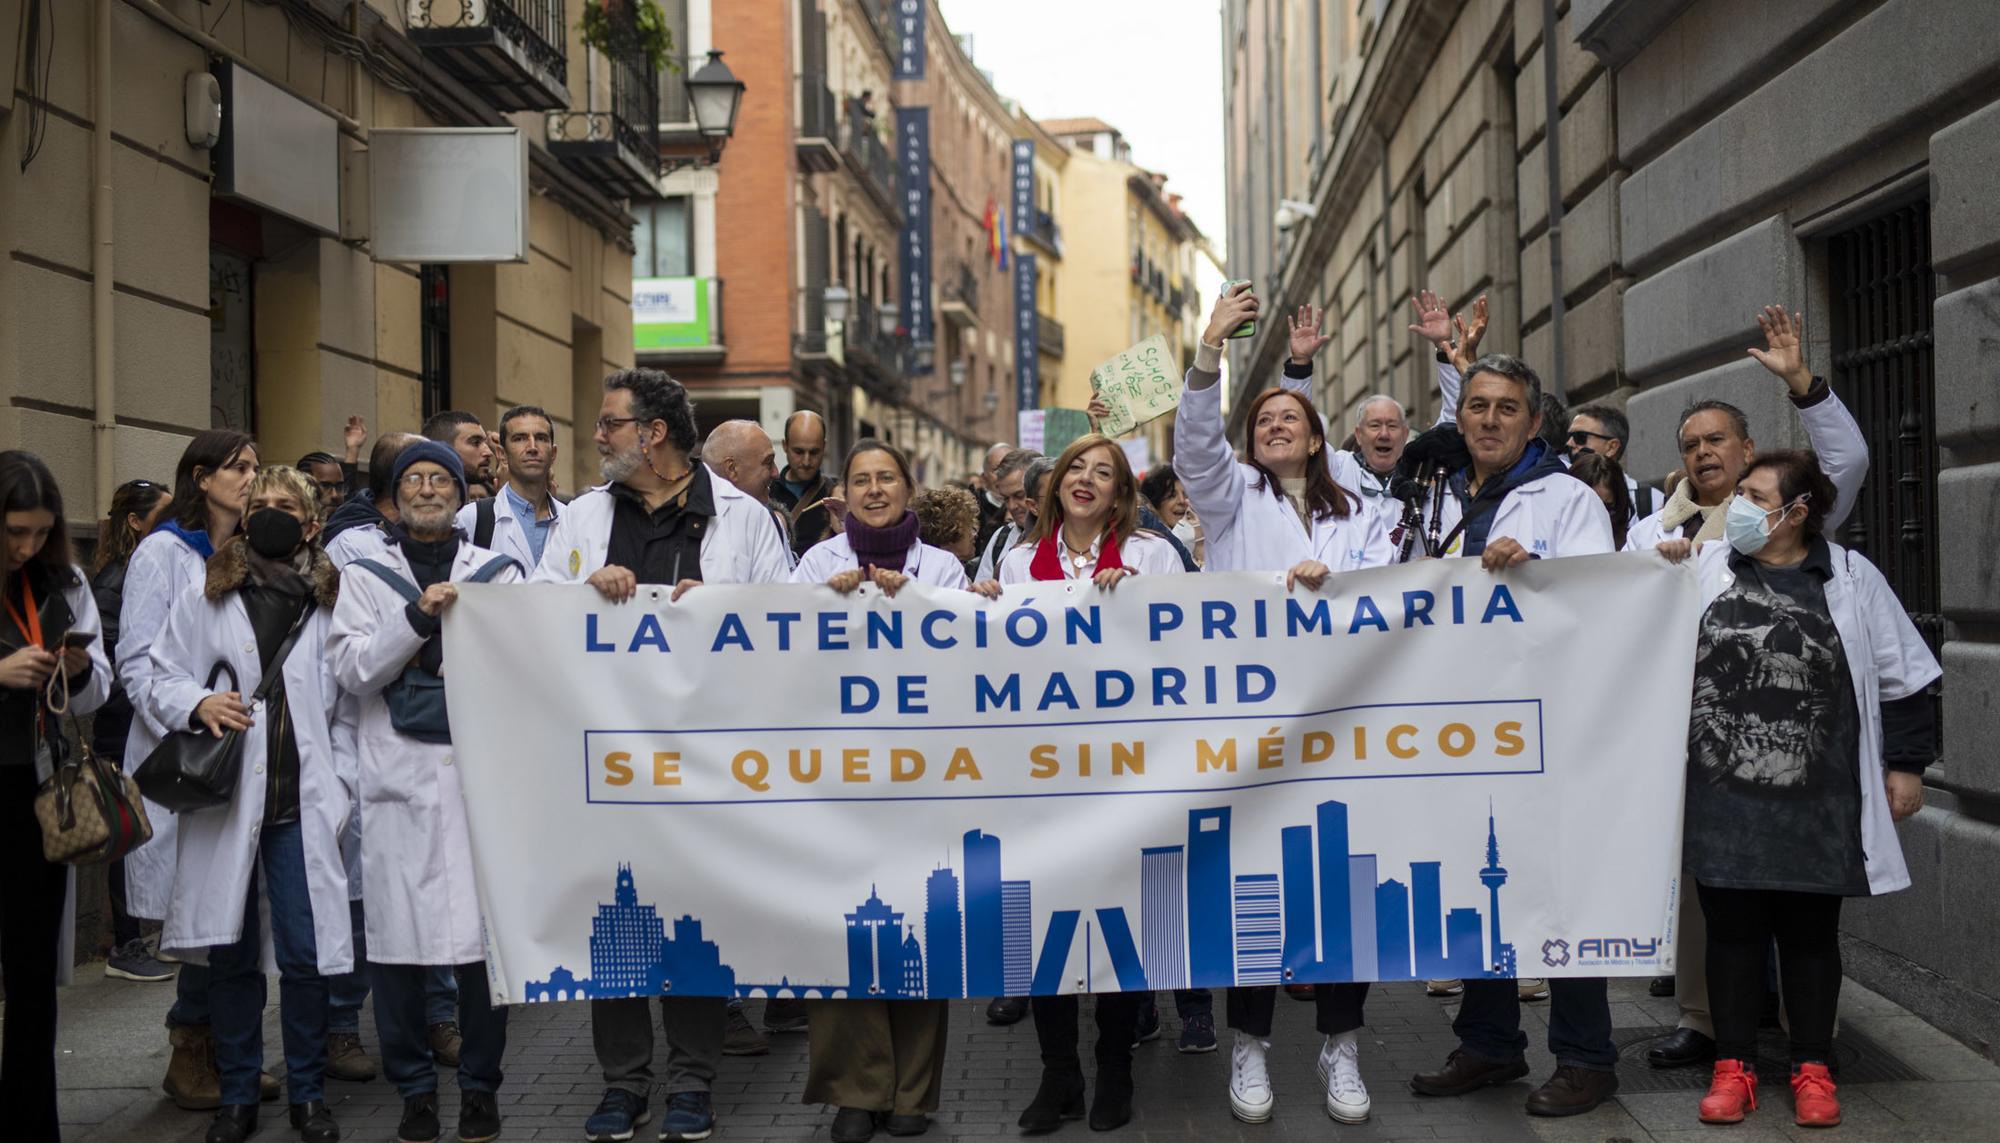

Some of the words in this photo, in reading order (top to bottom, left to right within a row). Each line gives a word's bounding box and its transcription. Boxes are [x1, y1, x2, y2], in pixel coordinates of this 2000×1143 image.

[1015, 163, 1031, 231] HOTEL
[585, 613, 671, 653] LA
[711, 599, 1102, 653] ATENCIÓN
[1149, 583, 1523, 641] PRIMARIA
[840, 674, 929, 715] DE
[975, 663, 1277, 713] MADRID
[604, 751, 682, 787] SE
[731, 746, 983, 792] QUEDA
[1030, 741, 1145, 779] SIN
[1196, 721, 1525, 773] MÉDICOS
[1578, 937, 1662, 958] AMY
